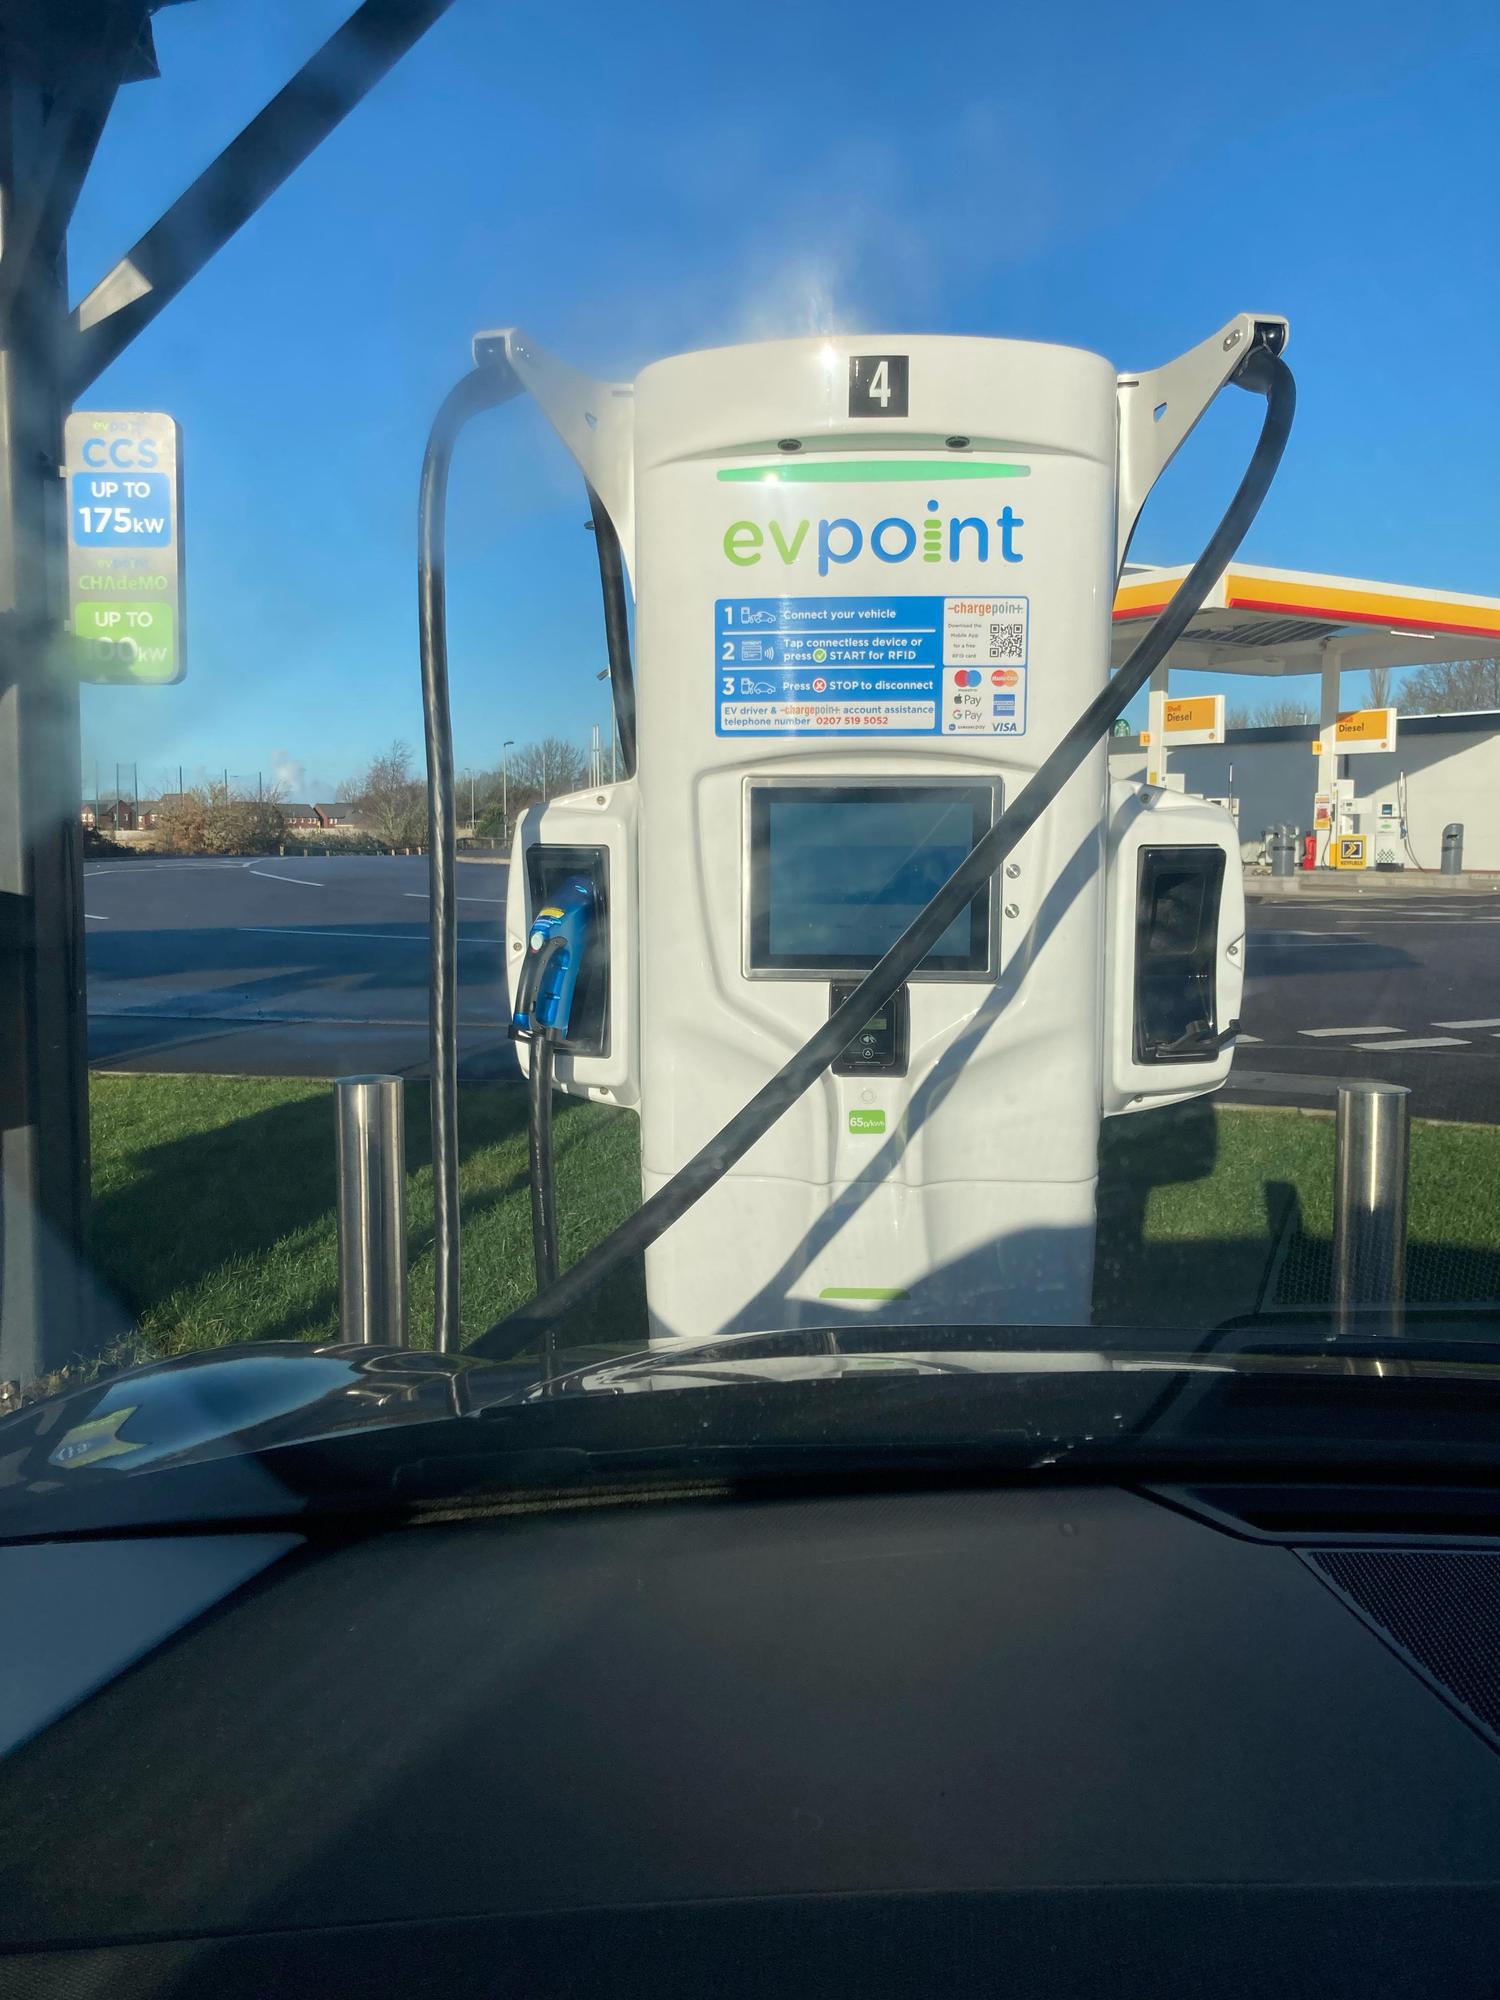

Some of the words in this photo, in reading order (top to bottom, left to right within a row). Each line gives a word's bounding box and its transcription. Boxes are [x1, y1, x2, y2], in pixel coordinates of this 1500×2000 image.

[869, 361, 891, 408] 4
[82, 438, 159, 468] CCS
[91, 481, 119, 498] UP
[123, 481, 151, 498] TO
[78, 507, 165, 534] 175kW
[723, 499, 1025, 577] evpoint
[95, 611, 121, 627] UP
[126, 611, 153, 627] TO
[724, 606, 733, 625] 1
[783, 610, 828, 620] Connect
[831, 611, 855, 621] your
[858, 609, 896, 619] vehicle
[783, 639, 803, 649] Tap
[872, 637, 908, 647] device
[910, 638, 923, 647] or
[722, 642, 735, 660] 2
[783, 652, 812, 662] press
[829, 651, 866, 660] START
[868, 650, 885, 660] for
[888, 650, 917, 660] RFID
[722, 677, 735, 696] 3
[783, 682, 811, 691] Press
[829, 681, 859, 690] STOP
[861, 681, 873, 690] to
[875, 680, 934, 690] disconnect
[964, 694, 982, 707] Pay
[724, 706, 738, 715] EV
[740, 706, 768, 715] driver
[770, 706, 777, 715] &
[843, 706, 882, 714] account
[884, 705, 934, 714] assistance
[964, 709, 982, 722] Pay
[1167, 711, 1193, 722] Diesel
[724, 718, 771, 727] telephone
[774, 717, 811, 726] number
[816, 716, 842, 725] 0207
[844, 716, 861, 725] 519
[863, 716, 888, 725] 5052
[992, 722, 1017, 732] VISA
[1338, 722, 1365, 733] Diesel
